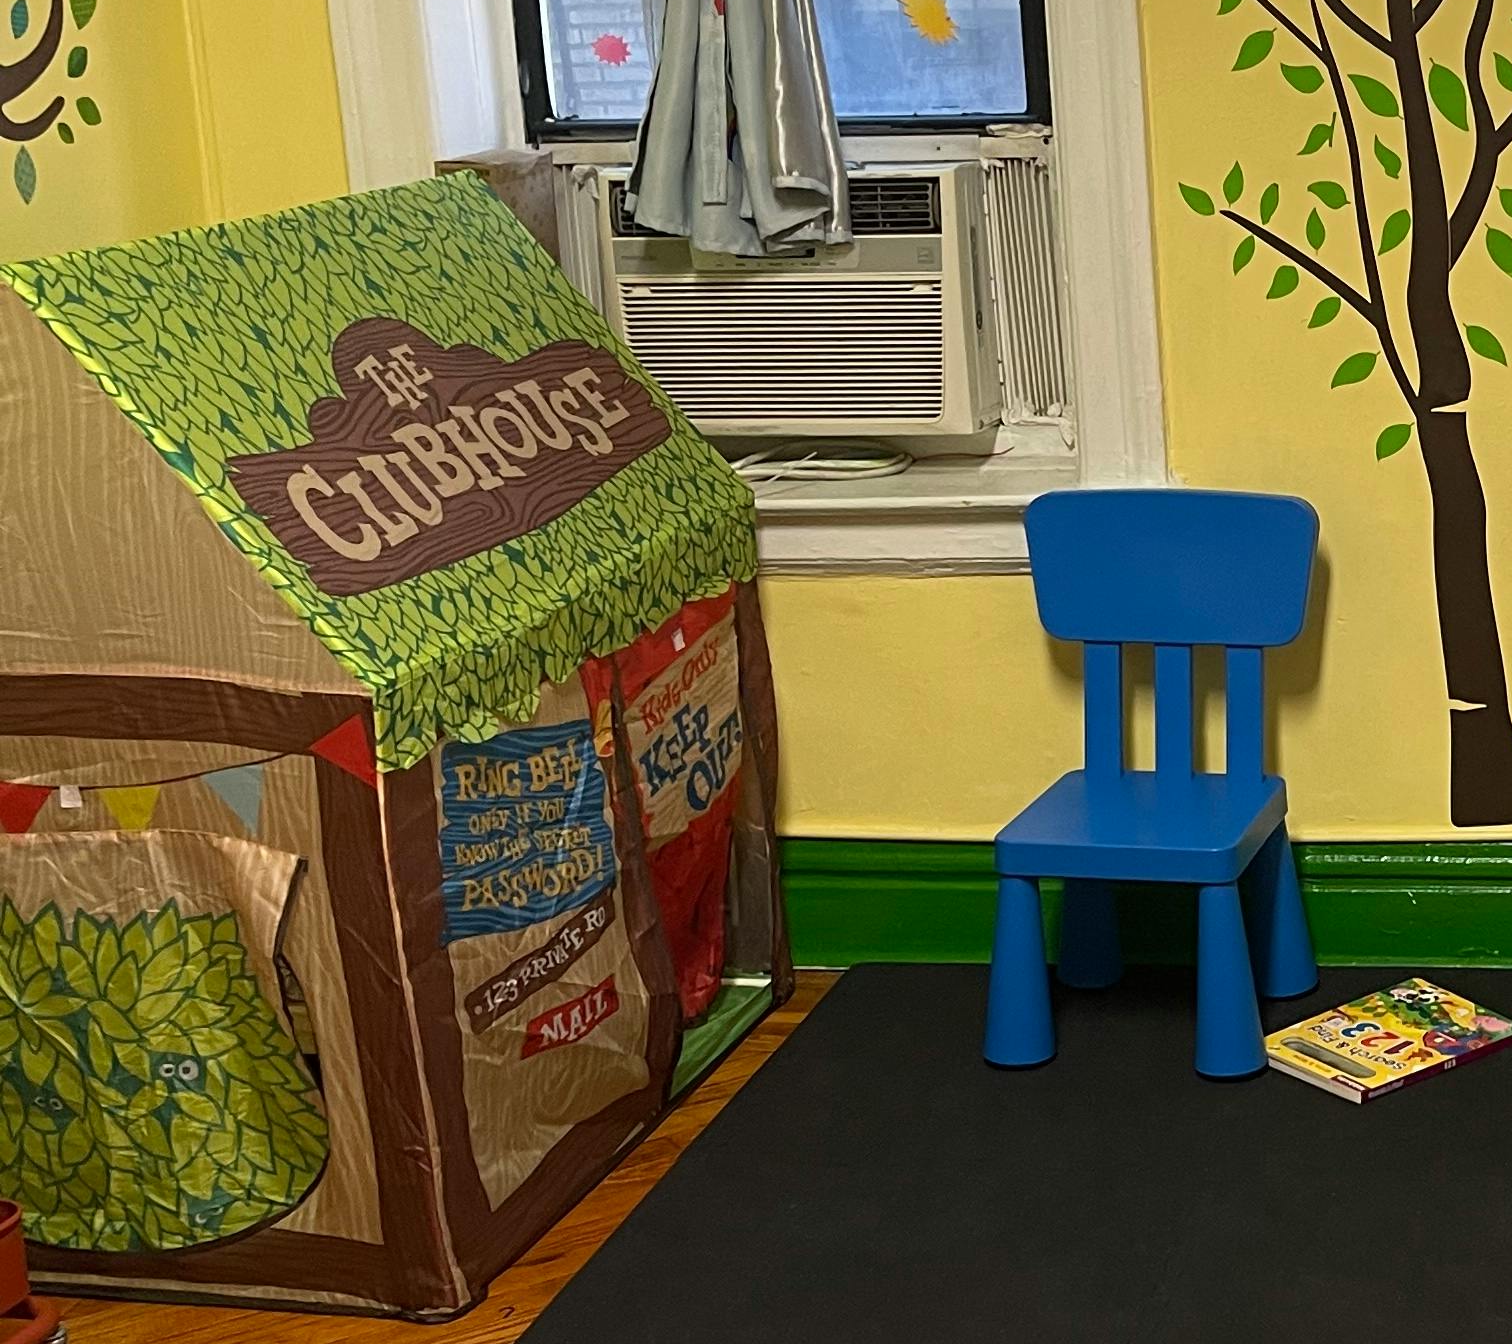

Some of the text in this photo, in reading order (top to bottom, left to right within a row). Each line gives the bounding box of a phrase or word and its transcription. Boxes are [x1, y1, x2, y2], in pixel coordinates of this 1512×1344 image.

[353, 343, 434, 410] THE
[286, 367, 631, 562] CLUBHOUSE
[454, 756, 521, 801] RING
[638, 704, 711, 797] KEEP
[454, 824, 592, 865] KNOW THE SECRET
[468, 797, 565, 835] ONLY IF YOU
[460, 844, 604, 912] PASSWORD!
[483, 979, 519, 1012] 123
[519, 927, 585, 987] PRIVATE
[539, 987, 608, 1048] MAIL
